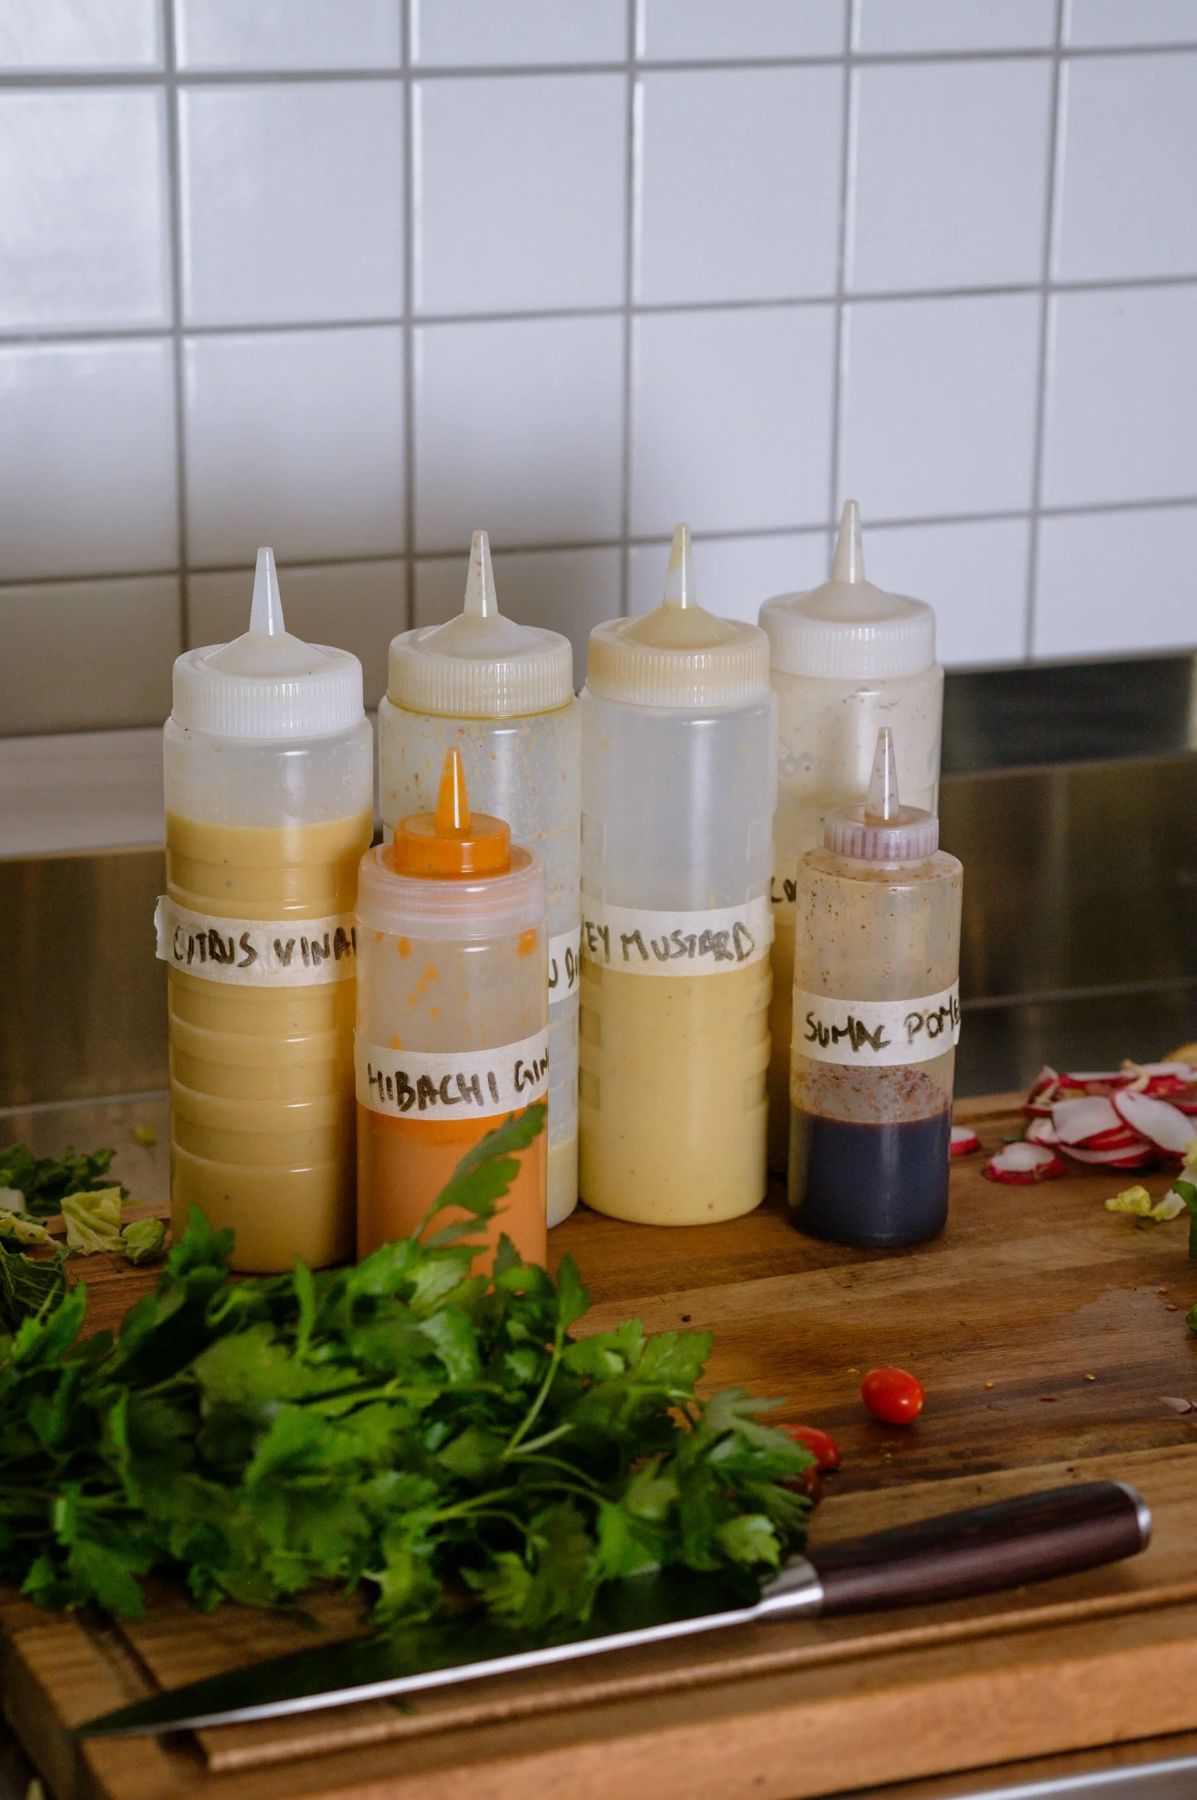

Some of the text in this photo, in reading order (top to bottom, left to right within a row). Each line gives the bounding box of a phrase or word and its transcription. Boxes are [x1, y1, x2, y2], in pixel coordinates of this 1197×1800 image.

[173, 925, 258, 968] CITRUS
[620, 921, 755, 962] MUSTARD
[804, 1010, 892, 1052] SUMAC
[367, 1062, 499, 1112] HIBACHI
